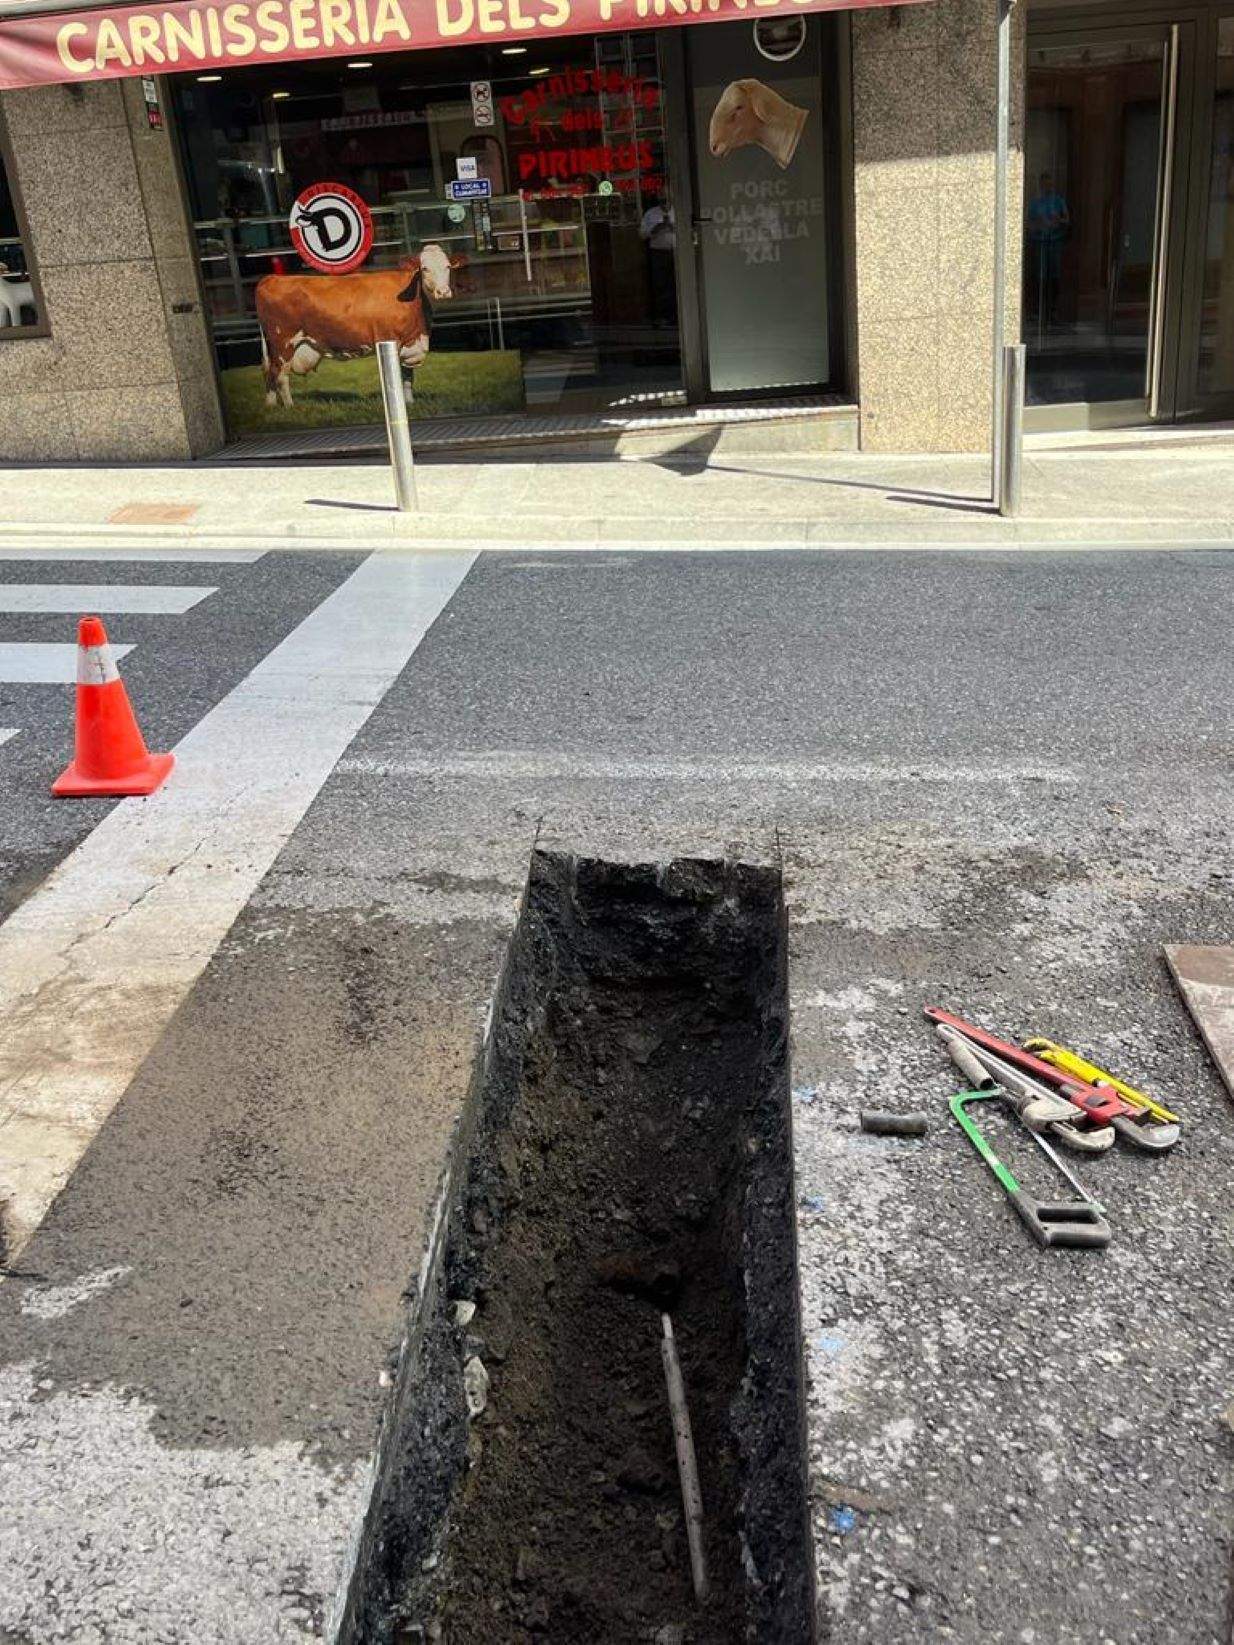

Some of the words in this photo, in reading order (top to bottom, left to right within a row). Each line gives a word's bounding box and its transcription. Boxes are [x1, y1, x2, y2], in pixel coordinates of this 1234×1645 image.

[56, 0, 410, 74] CARNISSERIA
[435, 0, 571, 37] DELS
[730, 179, 787, 200] PORC
[302, 207, 352, 252] D
[744, 245, 782, 265] XAI
